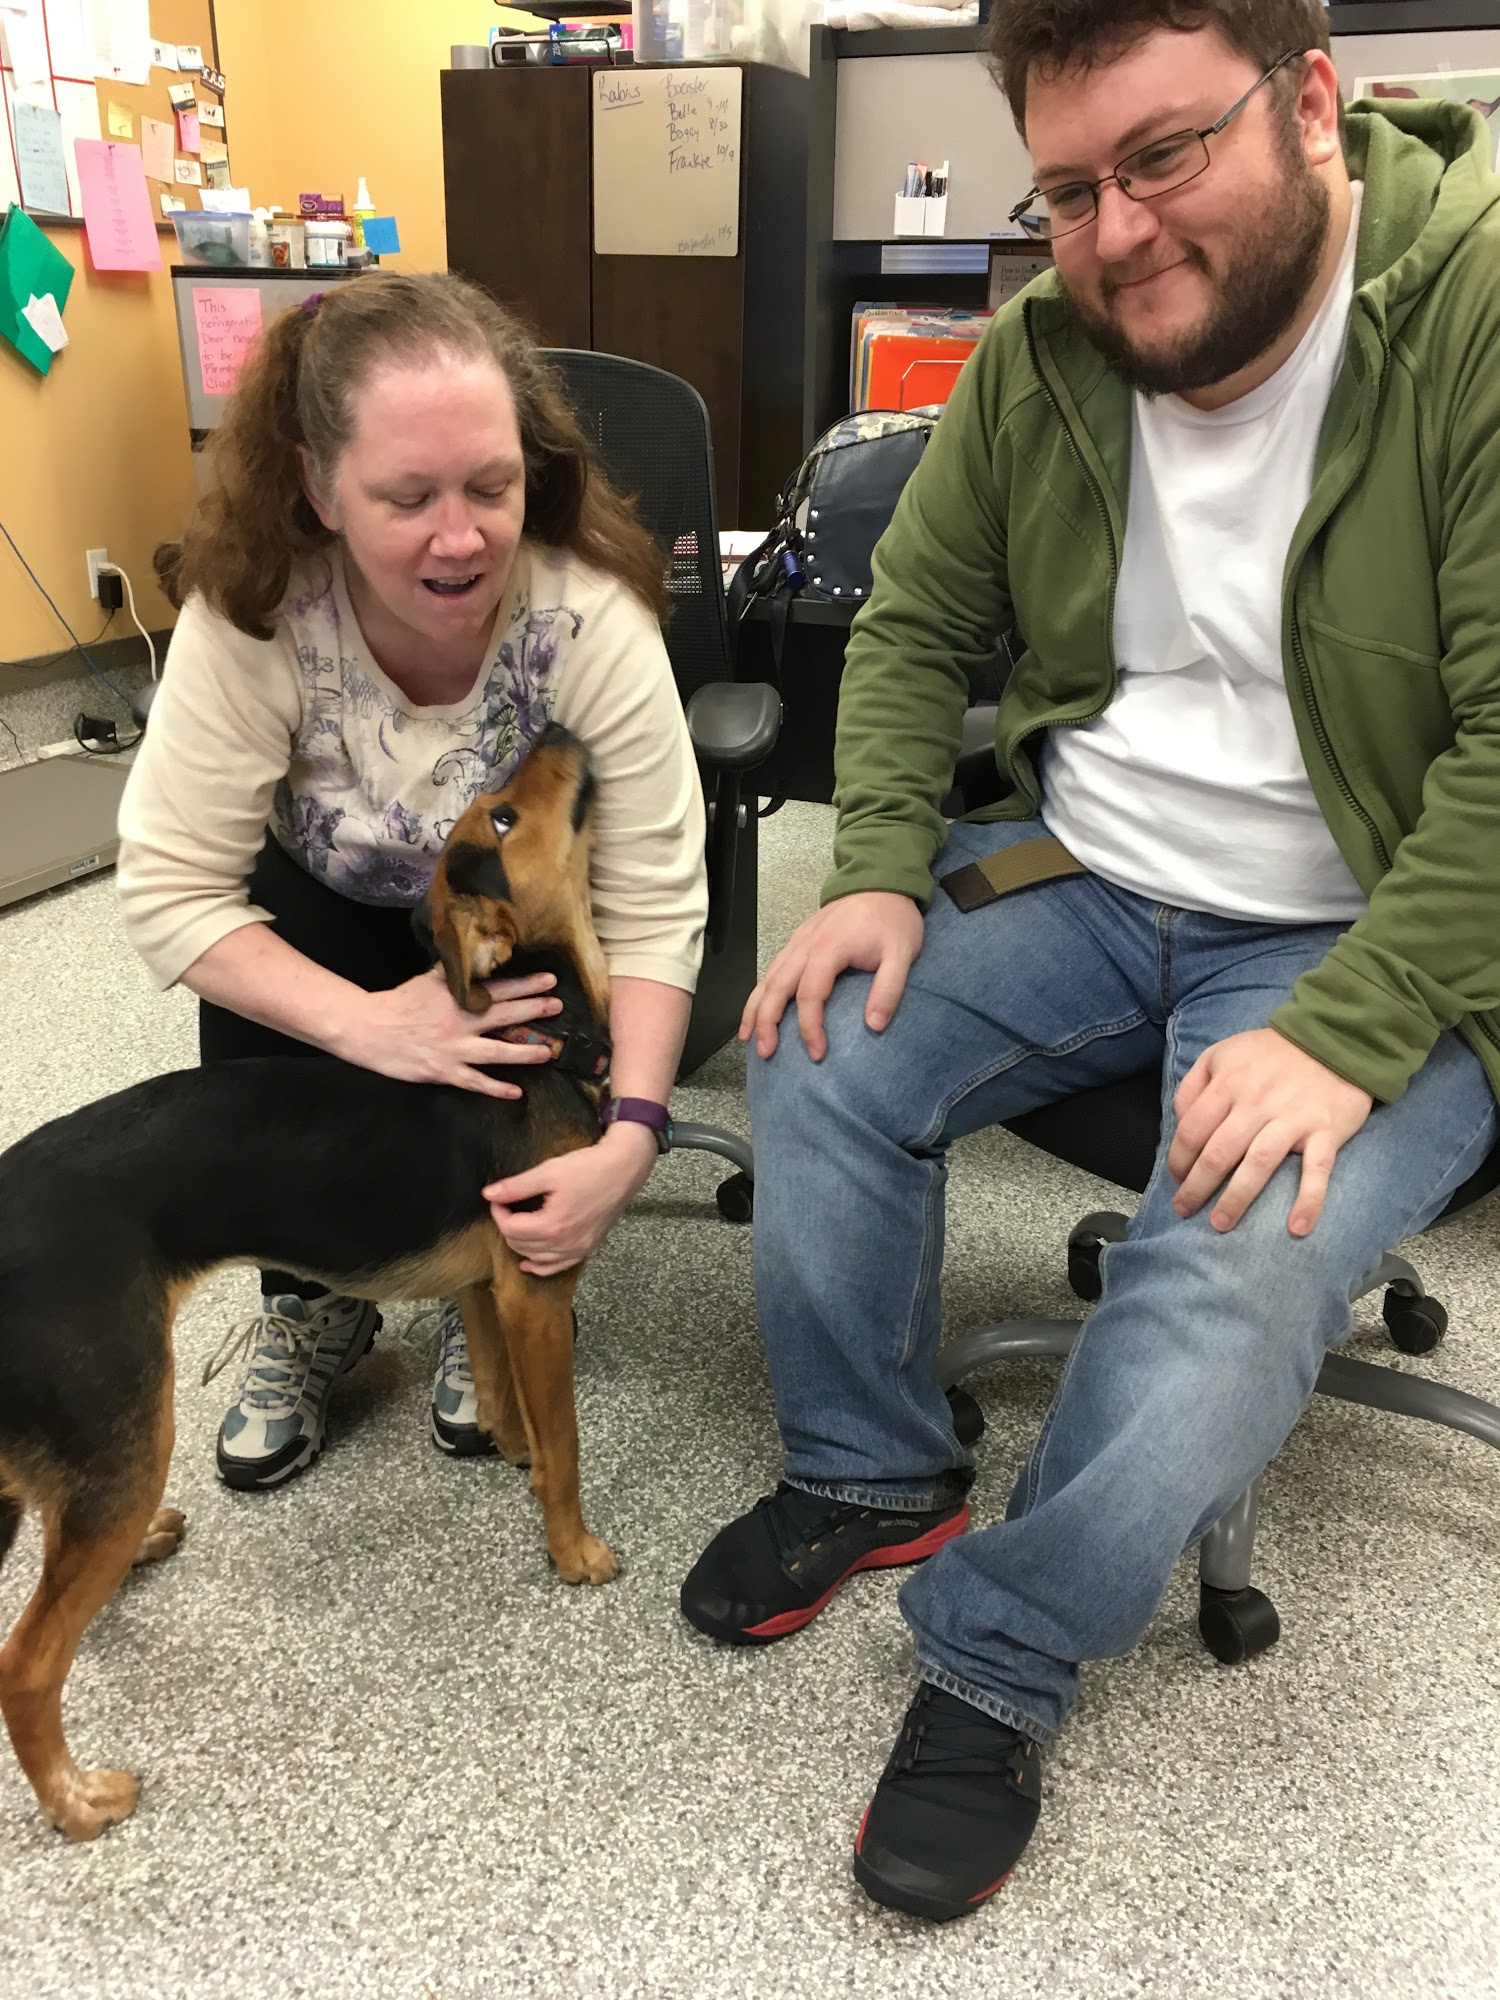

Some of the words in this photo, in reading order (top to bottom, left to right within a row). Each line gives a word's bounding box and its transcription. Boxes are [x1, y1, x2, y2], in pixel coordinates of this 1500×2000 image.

[551, 30, 562, 56] Zipoc
[660, 73, 710, 98] Booster
[667, 102, 697, 121] Bella
[666, 122, 700, 142] Bogey
[668, 144, 714, 174] Frankie
[198, 298, 226, 313] This
[201, 332, 224, 344] Door
[202, 349, 214, 360] to
[220, 347, 233, 360] be
[877, 1520, 894, 1529] new
[893, 1518, 921, 1529] balance
